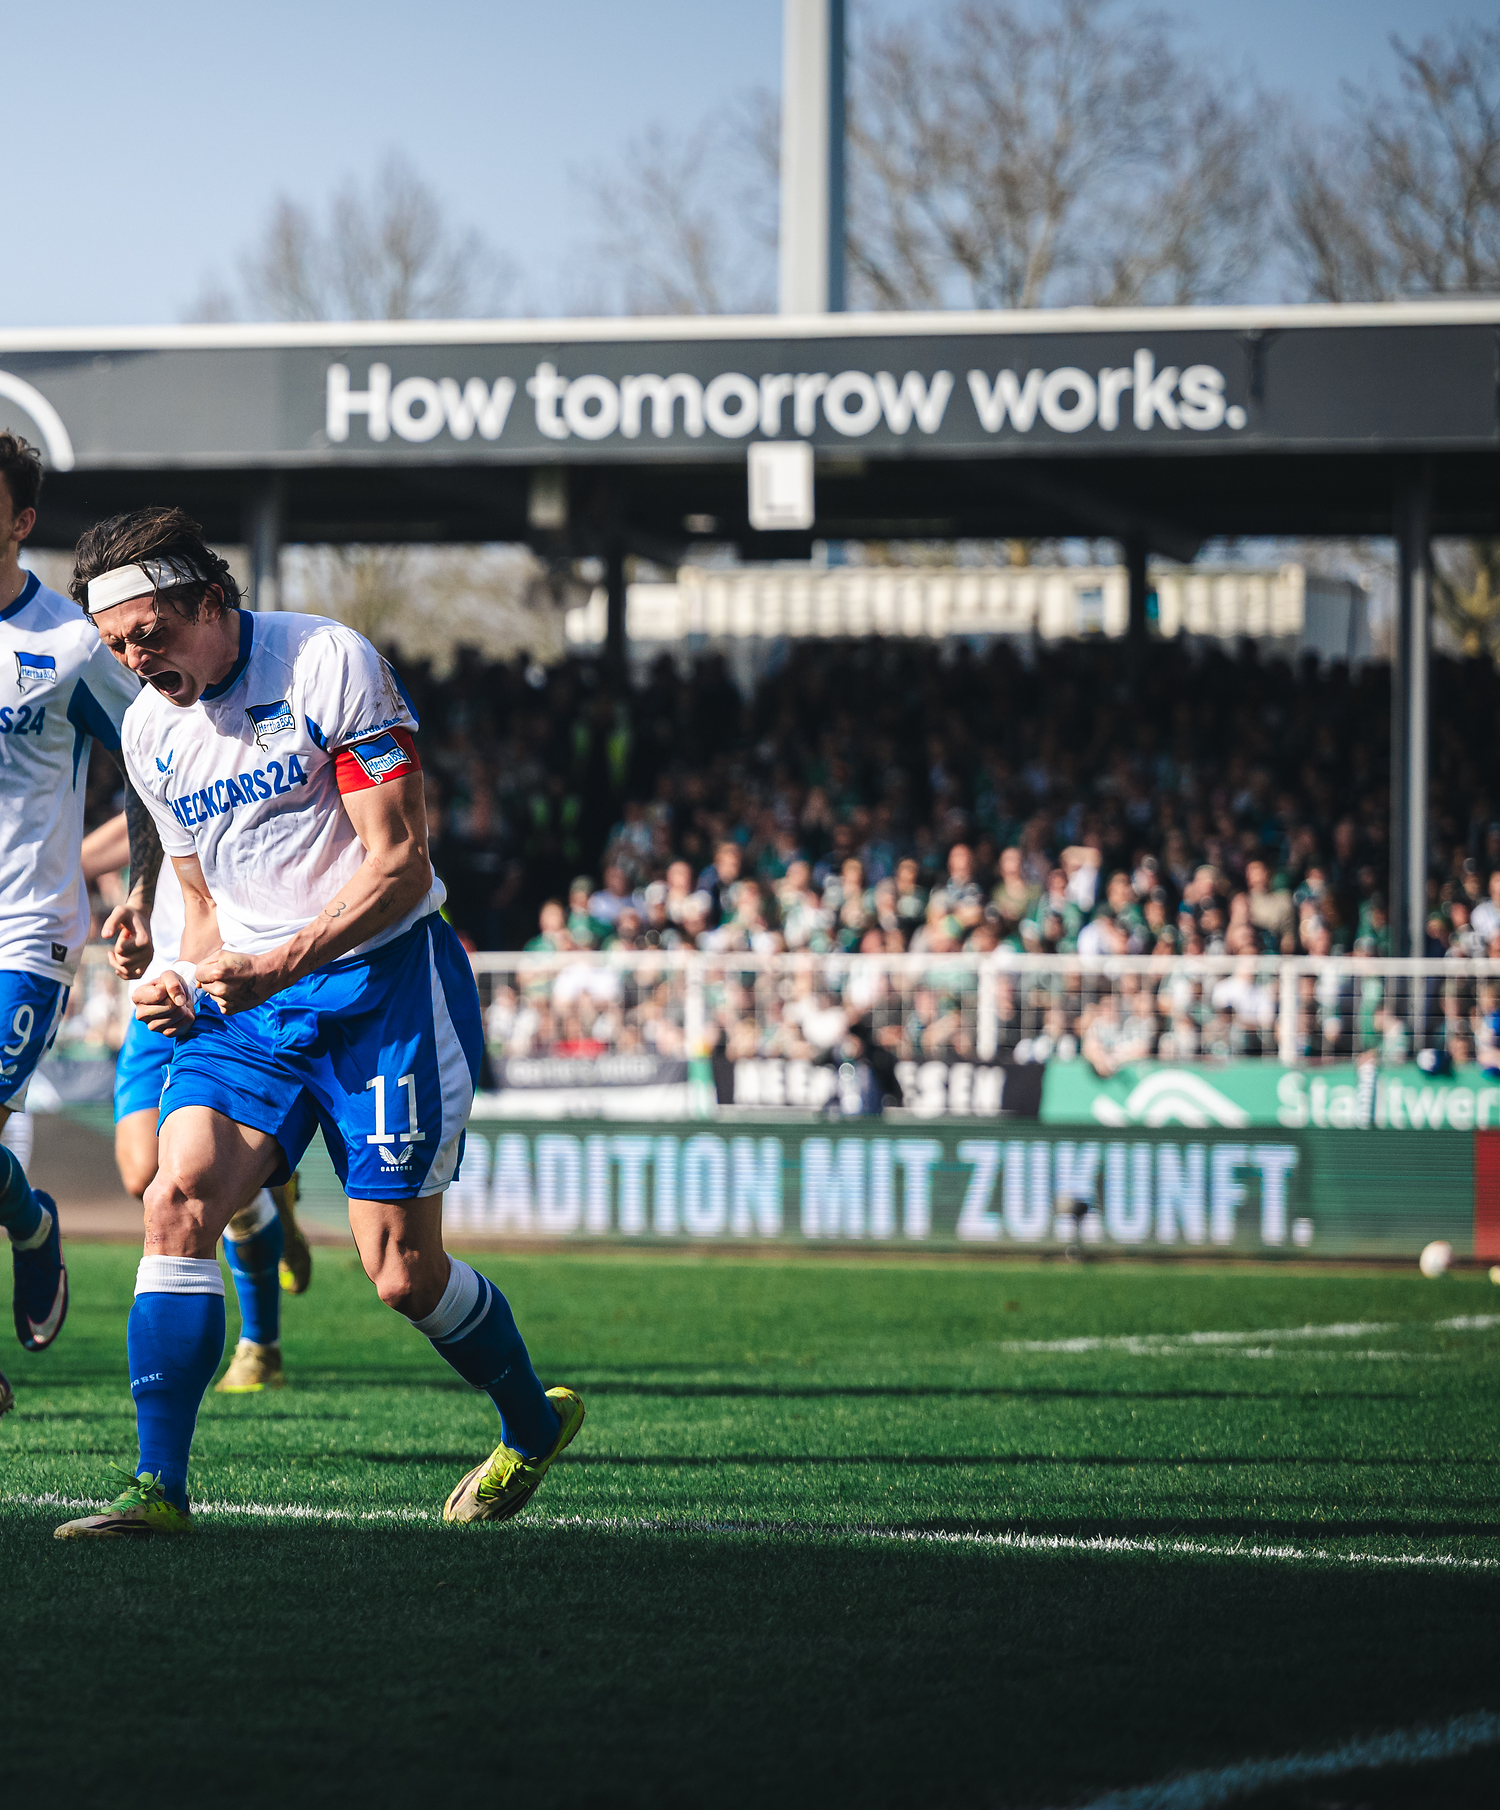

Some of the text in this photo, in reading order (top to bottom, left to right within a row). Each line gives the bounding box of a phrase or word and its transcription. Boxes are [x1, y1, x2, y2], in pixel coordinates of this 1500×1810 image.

[327, 348, 1247, 443] How tomorrow works.
[3, 1004, 35, 1056] 9
[366, 1074, 426, 1144] 11
[1277, 1071, 1500, 1131] Statwer
[443, 1133, 1314, 1247] RADITION MIT ZUKUNFT.
